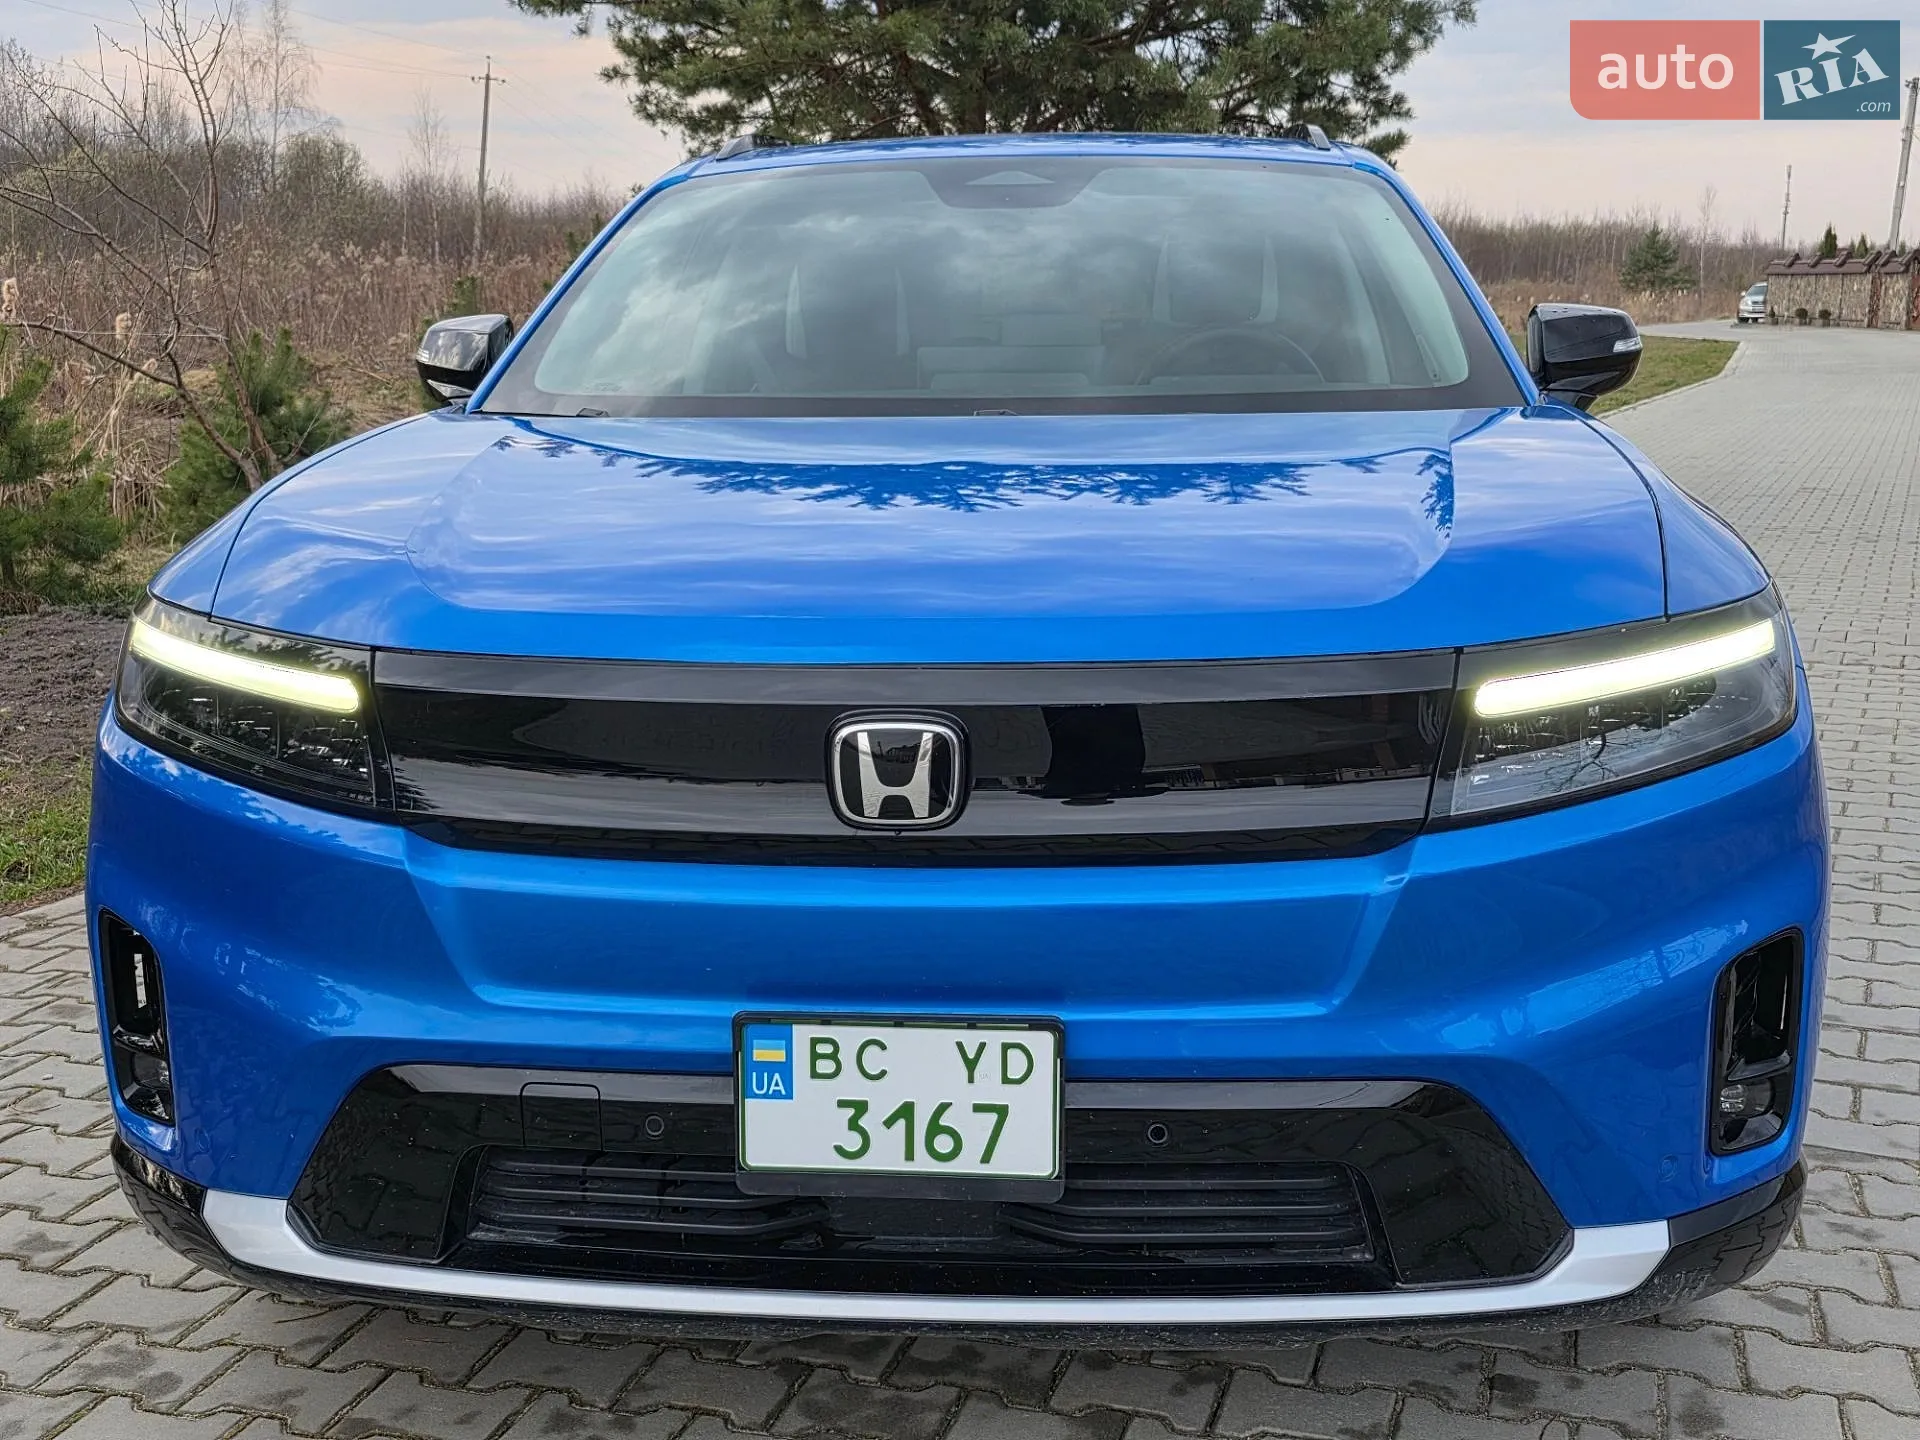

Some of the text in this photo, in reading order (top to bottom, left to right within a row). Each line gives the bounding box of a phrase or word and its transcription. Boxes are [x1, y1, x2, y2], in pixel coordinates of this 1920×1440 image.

[752, 1072, 786, 1095] UA
[809, 1036, 1034, 1084] BC YD
[833, 1099, 1010, 1164] 3167
